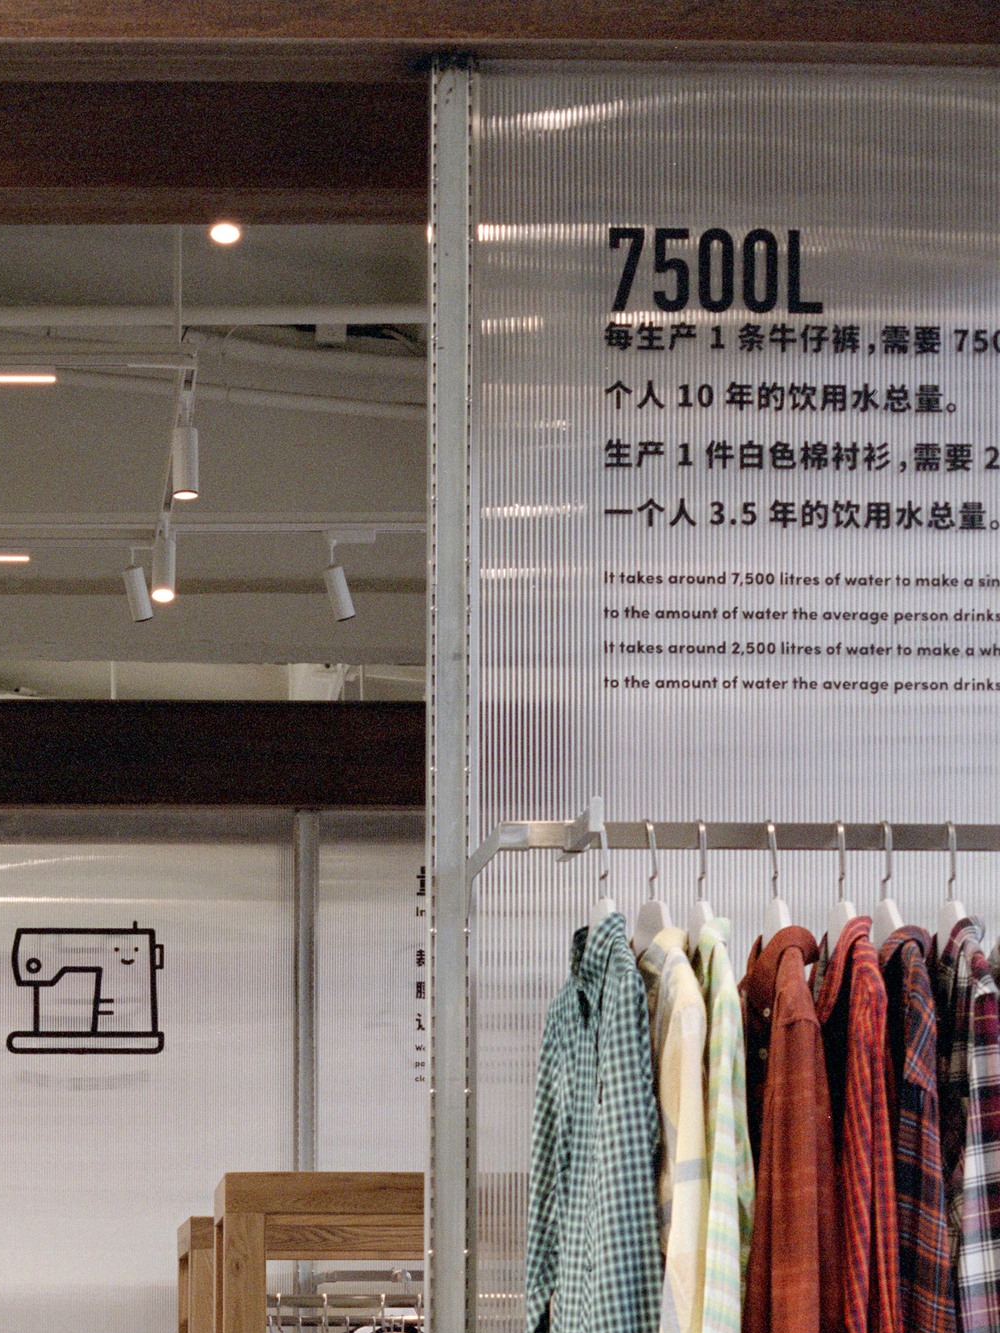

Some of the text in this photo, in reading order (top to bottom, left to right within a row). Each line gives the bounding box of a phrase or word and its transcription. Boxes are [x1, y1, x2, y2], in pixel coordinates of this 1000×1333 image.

[609, 227, 823, 314] 7500L
[604, 321, 698, 351] 每生产
[710, 325, 725, 349] 1
[604, 380, 957, 413] 个人 10 年的饮用水总量。
[604, 439, 665, 468] 生产
[677, 442, 693, 466] 1
[604, 498, 999, 531] 一个人 3.5 年的饮用水总量。
[604, 571, 615, 585] It
[619, 571, 663, 585] takes
[668, 572, 726, 585] around
[731, 572, 775, 587] 7,500
[780, 572, 820, 587] litres
[825, 573, 841, 587] of
[845, 574, 891, 587] water
[896, 574, 911, 587] to
[916, 574, 959, 587] make
[964, 577, 973, 587] a
[604, 606, 619, 619] to
[624, 606, 650, 619] the
[655, 607, 718, 619] amount
[722, 607, 739, 620] of
[742, 608, 788, 620] water
[792, 607, 818, 621] the
[822, 610, 889, 624] average
[894, 610, 948, 624] person
[604, 640, 615, 654] It
[619, 640, 663, 654] takes
[668, 641, 726, 655] around
[731, 642, 776, 656] 2,500
[781, 641, 821, 656] litres
[826, 642, 842, 655] of
[846, 643, 892, 656] water
[897, 643, 912, 656] to
[917, 643, 960, 656] make
[965, 647, 975, 656] a
[604, 676, 619, 689] to
[624, 675, 650, 689] the
[655, 677, 718, 689] amount
[722, 676, 739, 689] of
[742, 677, 788, 689] water
[792, 676, 818, 690] the
[823, 680, 889, 694] average
[894, 680, 948, 694] person
